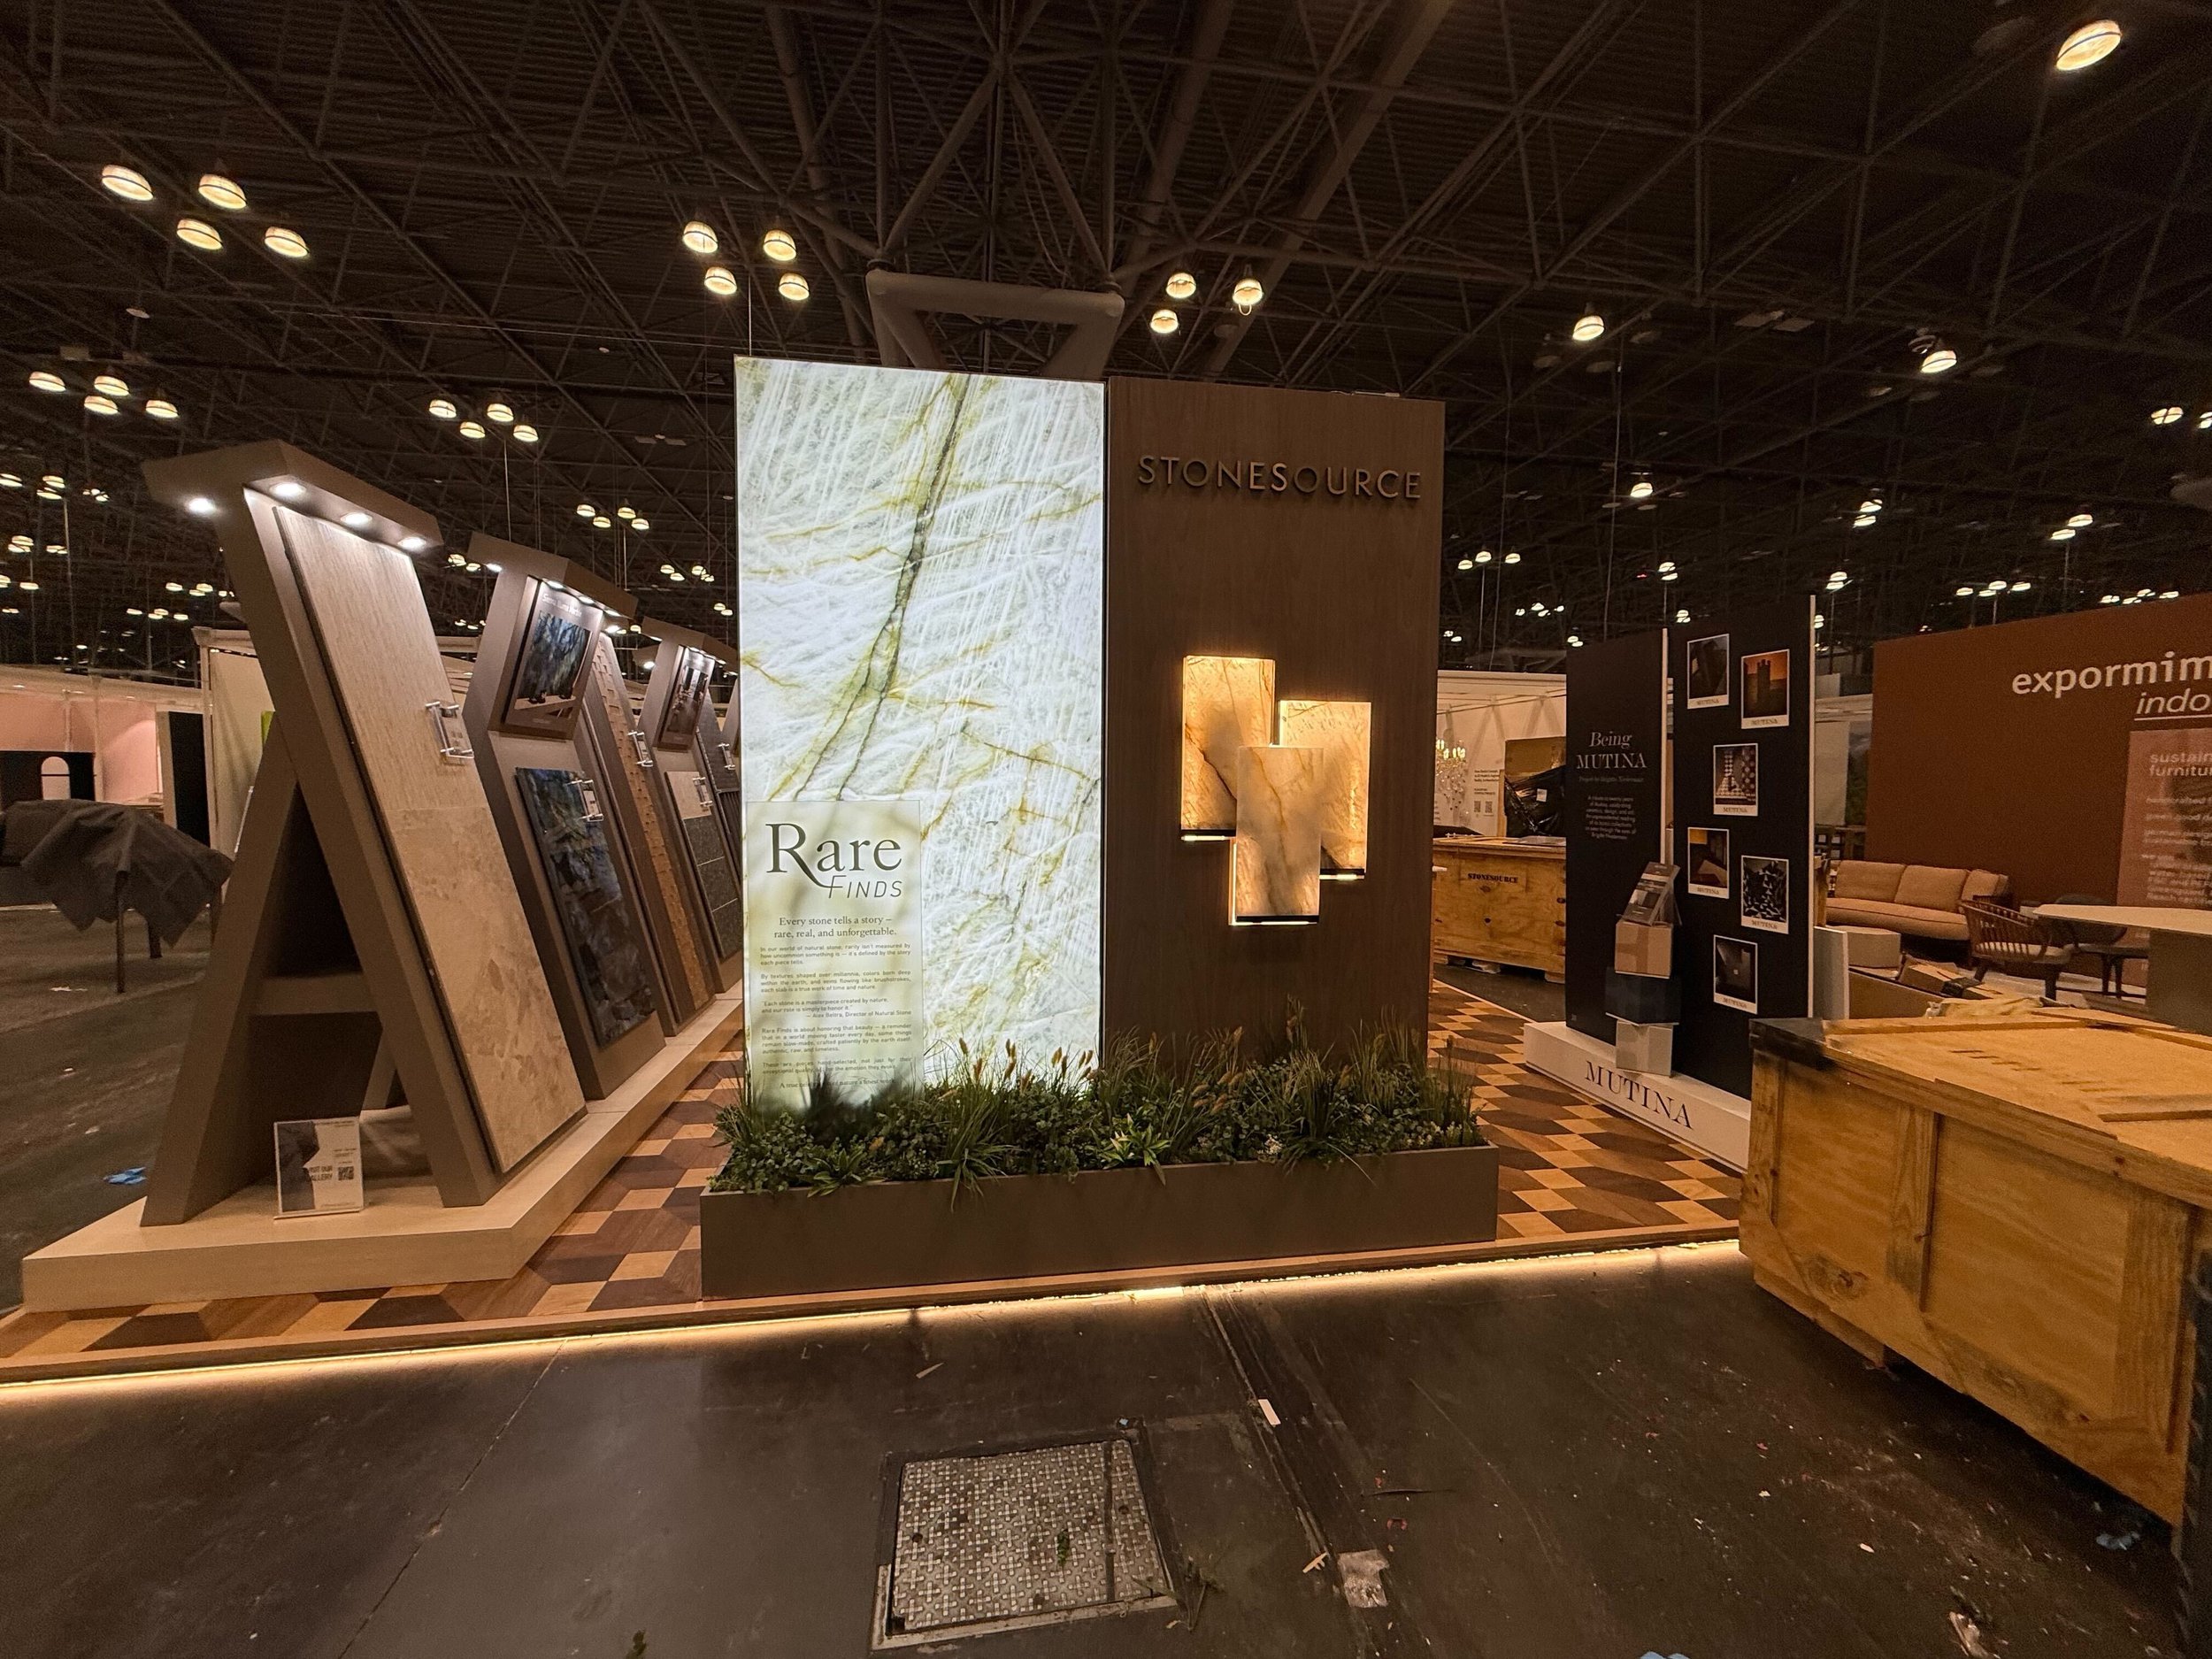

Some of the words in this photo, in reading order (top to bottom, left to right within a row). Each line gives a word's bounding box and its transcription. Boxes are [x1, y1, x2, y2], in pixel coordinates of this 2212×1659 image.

[1139, 455, 1422, 498] STONESOURCE
[2012, 650, 2212, 699] expormim
[2136, 688, 2211, 715] indo
[1589, 731, 1632, 749] Being
[1576, 753, 1647, 769] MUTINA
[765, 823, 902, 888] Rare
[1468, 872, 1518, 883] STONESOURCE
[780, 918, 806, 926] Every
[796, 929, 815, 938] real,
[837, 927, 896, 937] unforgettable.
[1585, 1060, 1693, 1129] MUTINA
